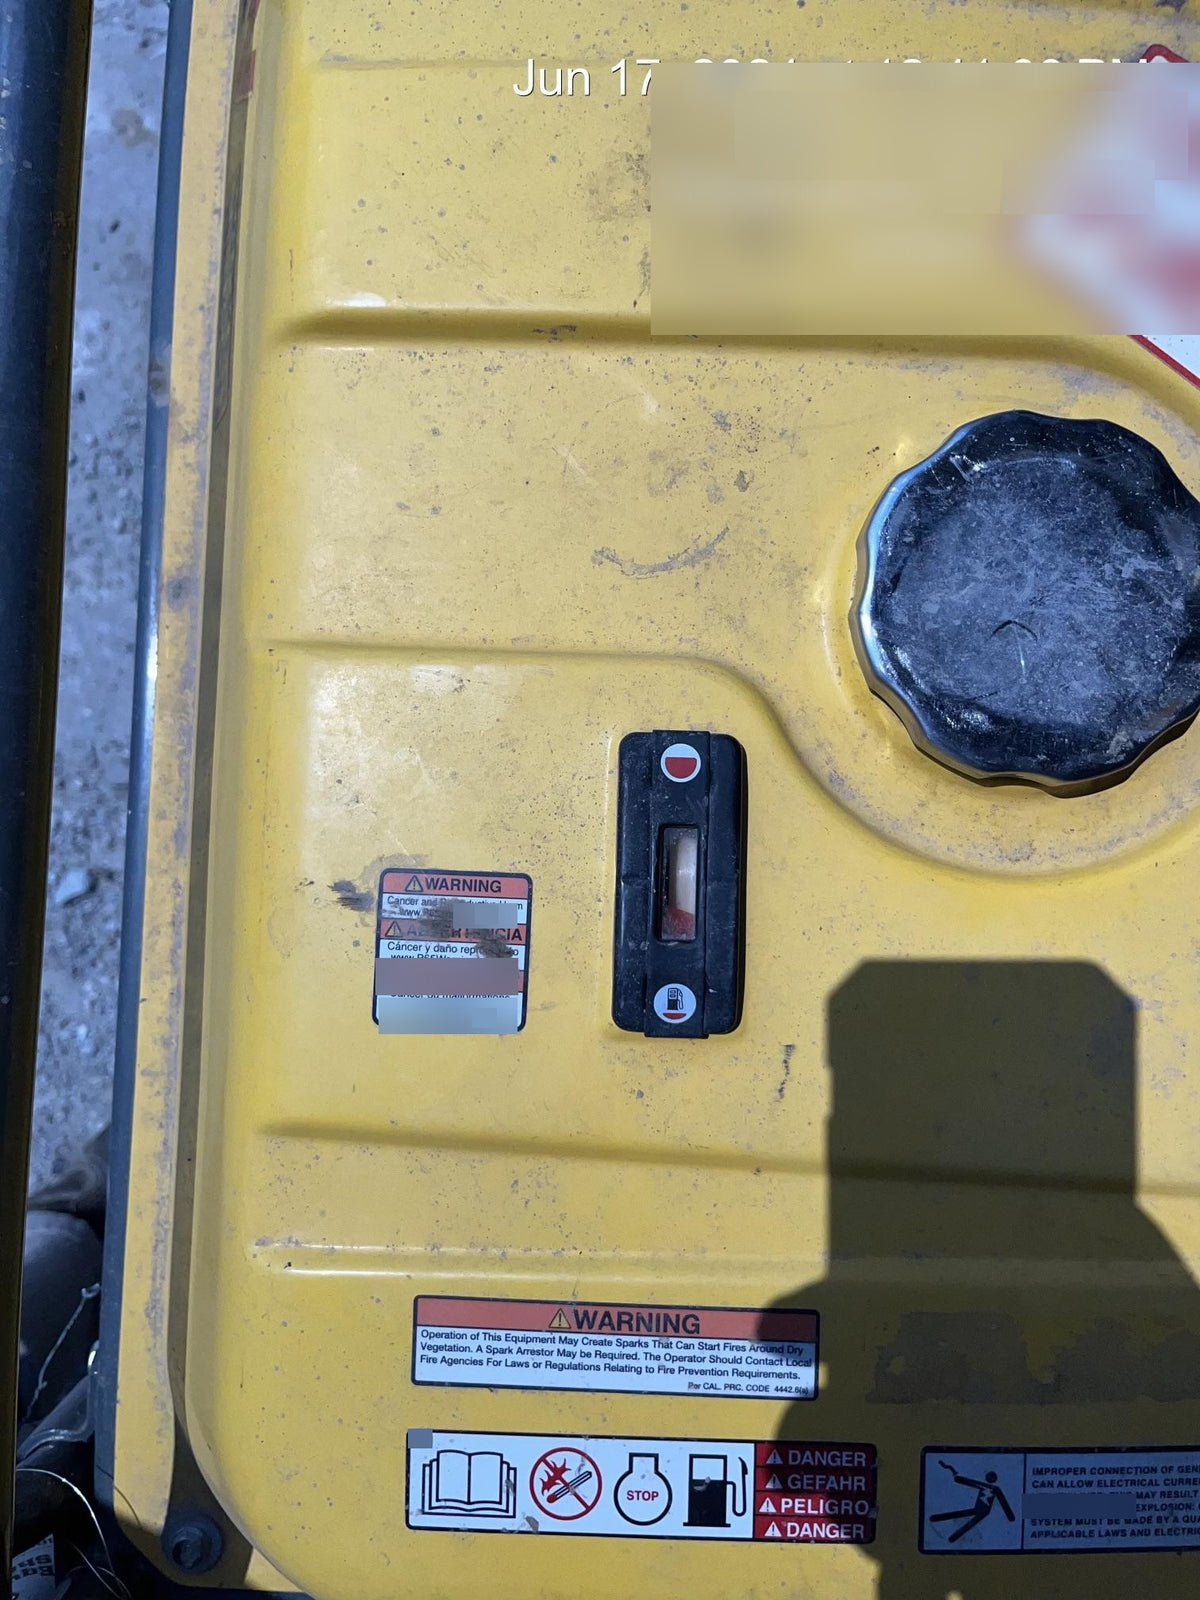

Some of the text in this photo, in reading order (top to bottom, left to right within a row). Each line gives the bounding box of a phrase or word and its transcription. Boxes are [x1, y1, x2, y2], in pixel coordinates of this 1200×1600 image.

[425, 877, 502, 893] WARNING
[387, 941, 422, 952] Cáncer
[425, 944, 431, 954] y
[433, 944, 458, 954] daño
[575, 1308, 700, 1335] WARNING
[421, 1330, 804, 1357] Operation of This Equipment May Create Sparks That Can Start Fires Around Dry
[420, 1342, 812, 1367] Vegetation. A Spark Arrestor May be Required. The Operator Should Contact Local
[420, 1355, 438, 1364] Fire
[440, 1356, 484, 1367] Agencies
[486, 1358, 501, 1367] For
[505, 1360, 530, 1369] Laws
[544, 1361, 601, 1373] Regulations
[603, 1363, 643, 1375] Relating
[645, 1365, 655, 1374] to
[657, 1365, 675, 1375] Fire
[678, 1367, 729, 1377] Prevention
[731, 1369, 801, 1380] Requirements.
[723, 1383, 744, 1392] PRC.
[745, 1384, 770, 1393] CODE
[788, 1450, 866, 1467] DANGER
[1032, 1467, 1087, 1476] IMPROPER
[1090, 1466, 1158, 1475] CONNECTION
[1160, 1465, 1174, 1474] OF
[787, 1473, 866, 1491] GEFAHR
[1032, 1480, 1054, 1489] CAN
[1056, 1479, 1093, 1488] ALLOW
[1096, 1478, 1160, 1487] ELECTRICAL
[626, 1490, 659, 1502] STOP
[1136, 1491, 1156, 1499] MAY
[1160, 1490, 1198, 1498] RESULT
[781, 1498, 869, 1516] PELIGRO
[786, 1522, 864, 1539] DANGER
[1030, 1529, 1095, 1538] APPLICABLE
[1098, 1529, 1127, 1537] LAWS
[1129, 1528, 1151, 1537] AND
